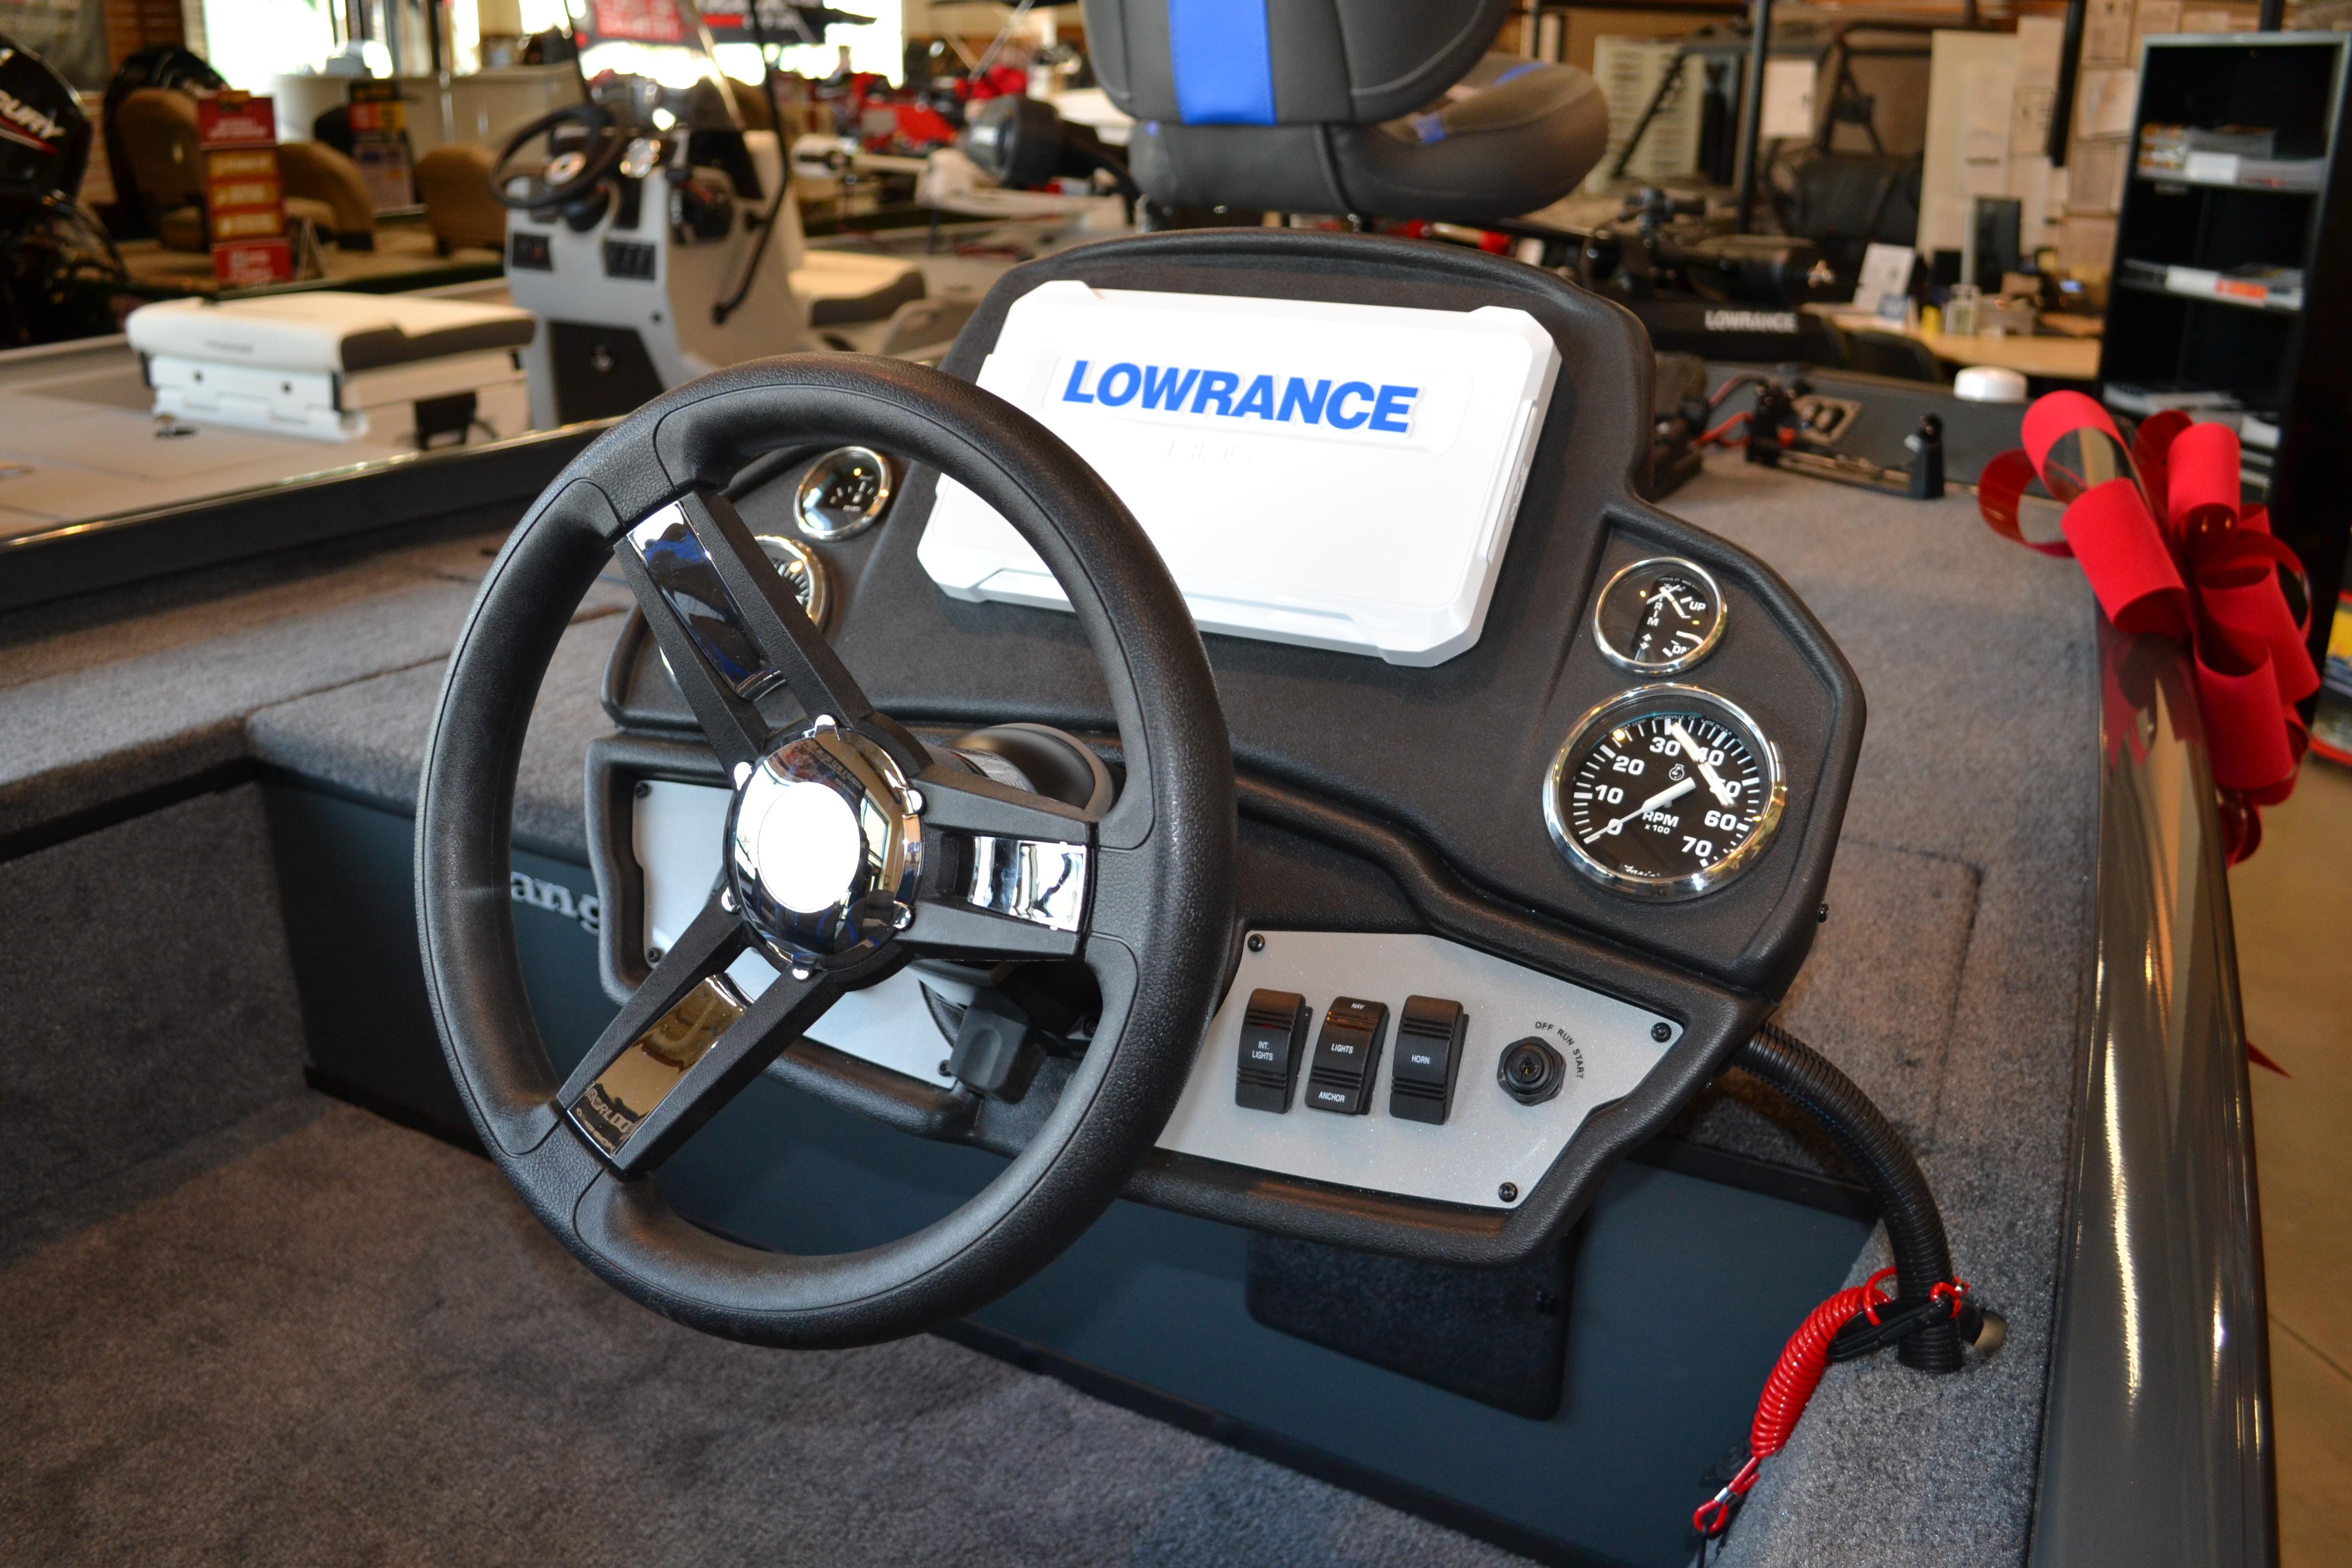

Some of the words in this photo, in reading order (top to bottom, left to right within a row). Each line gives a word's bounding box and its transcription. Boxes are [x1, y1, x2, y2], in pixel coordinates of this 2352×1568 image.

[1062, 360, 1418, 433] LOWRANCE
[1689, 601, 1706, 610] UP
[1649, 737, 1681, 756] 30
[1612, 755, 1645, 775] 20
[1697, 746, 1725, 766] 40
[1595, 784, 1624, 804] 10
[1607, 818, 1624, 836] 0
[1641, 811, 1679, 827] RPM
[1704, 810, 1736, 831] 60
[1653, 824, 1671, 835] 100
[1681, 836, 1712, 857] 70
[1258, 1041, 1269, 1049] INT.
[1331, 1043, 1354, 1054] LIGHTS
[1535, 1021, 1554, 1031] OFF
[1557, 1028, 1575, 1045] RUN
[1573, 1048, 1584, 1079] START
[1252, 1052, 1273, 1061] LIGHTS
[1411, 1055, 1430, 1065] HORN
[1318, 1091, 1345, 1102] ANCHOR
